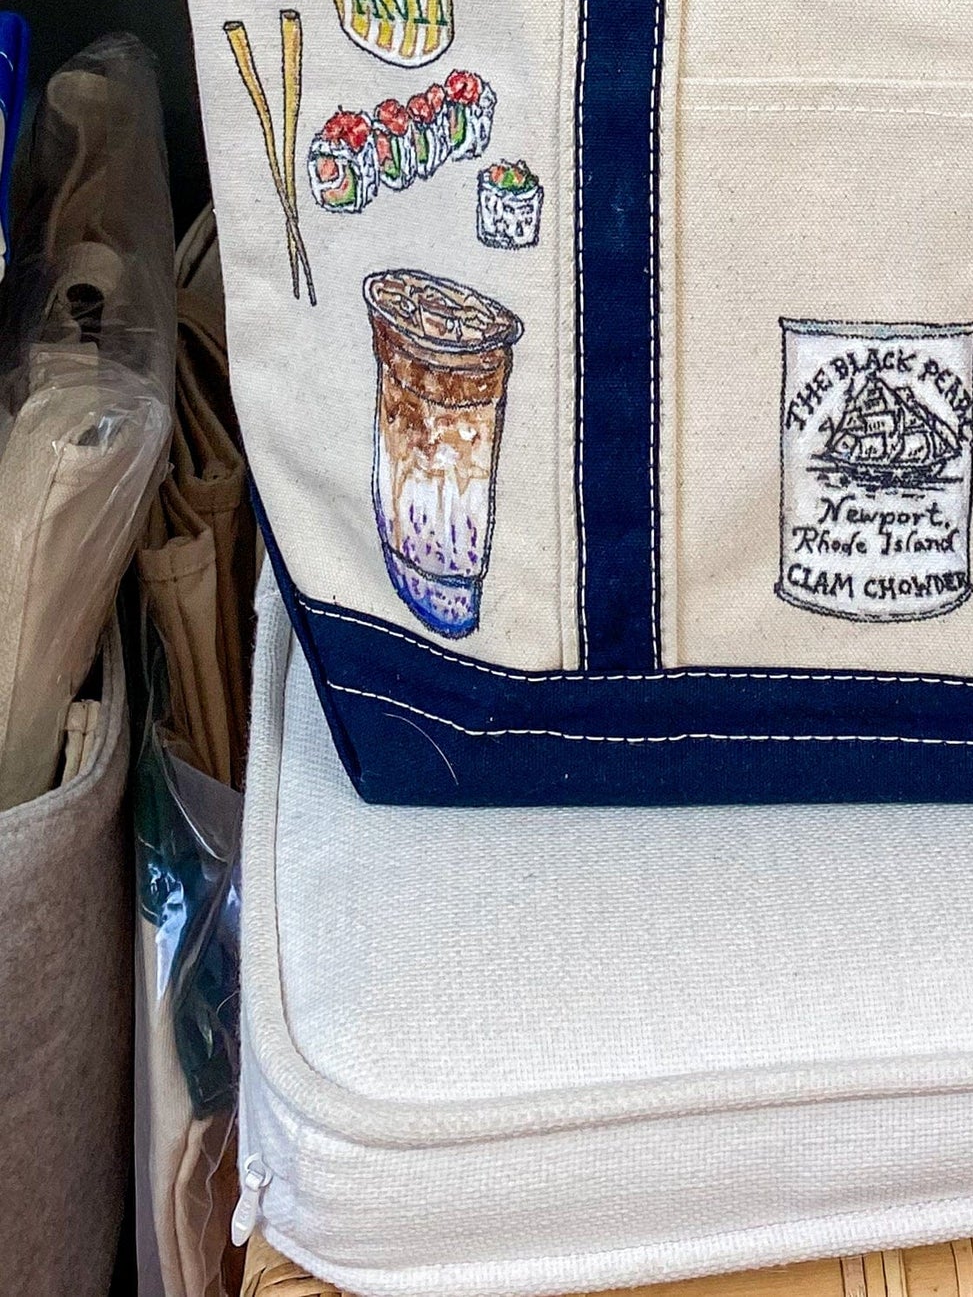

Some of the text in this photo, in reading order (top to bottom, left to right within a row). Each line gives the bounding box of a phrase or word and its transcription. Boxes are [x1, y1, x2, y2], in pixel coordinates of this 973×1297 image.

[785, 367, 833, 431] THE
[829, 348, 917, 381] BLACK
[792, 526, 961, 556] Rhode Island
[786, 563, 973, 599] CLAM CHOWDER
